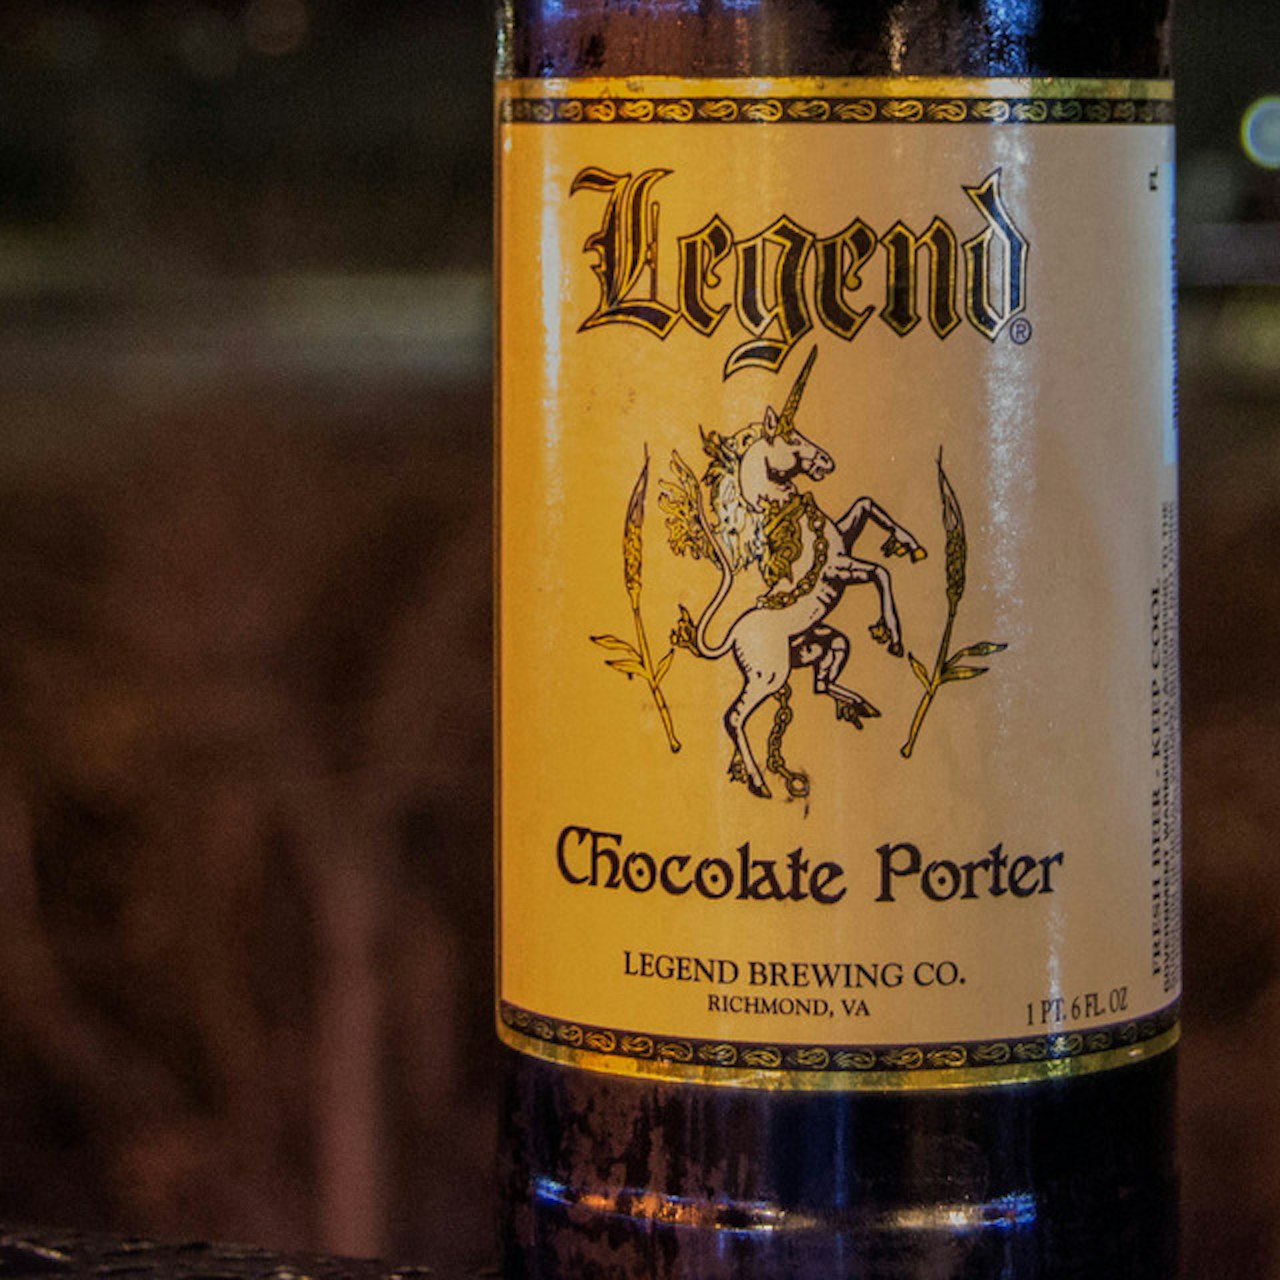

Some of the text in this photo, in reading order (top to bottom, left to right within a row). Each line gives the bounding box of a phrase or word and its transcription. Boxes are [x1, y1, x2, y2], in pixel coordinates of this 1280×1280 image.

[570, 166, 1028, 382] Legend
[556, 824, 1065, 904] Chocolate Porter
[623, 950, 967, 988] LEGEND BREWING CO.
[707, 993, 871, 1018] RICHMOND, VA
[1026, 1003, 1033, 1026] 1
[1040, 998, 1067, 1022] PT.
[1071, 995, 1081, 1021] 6
[1109, 985, 1128, 1013] OZ
